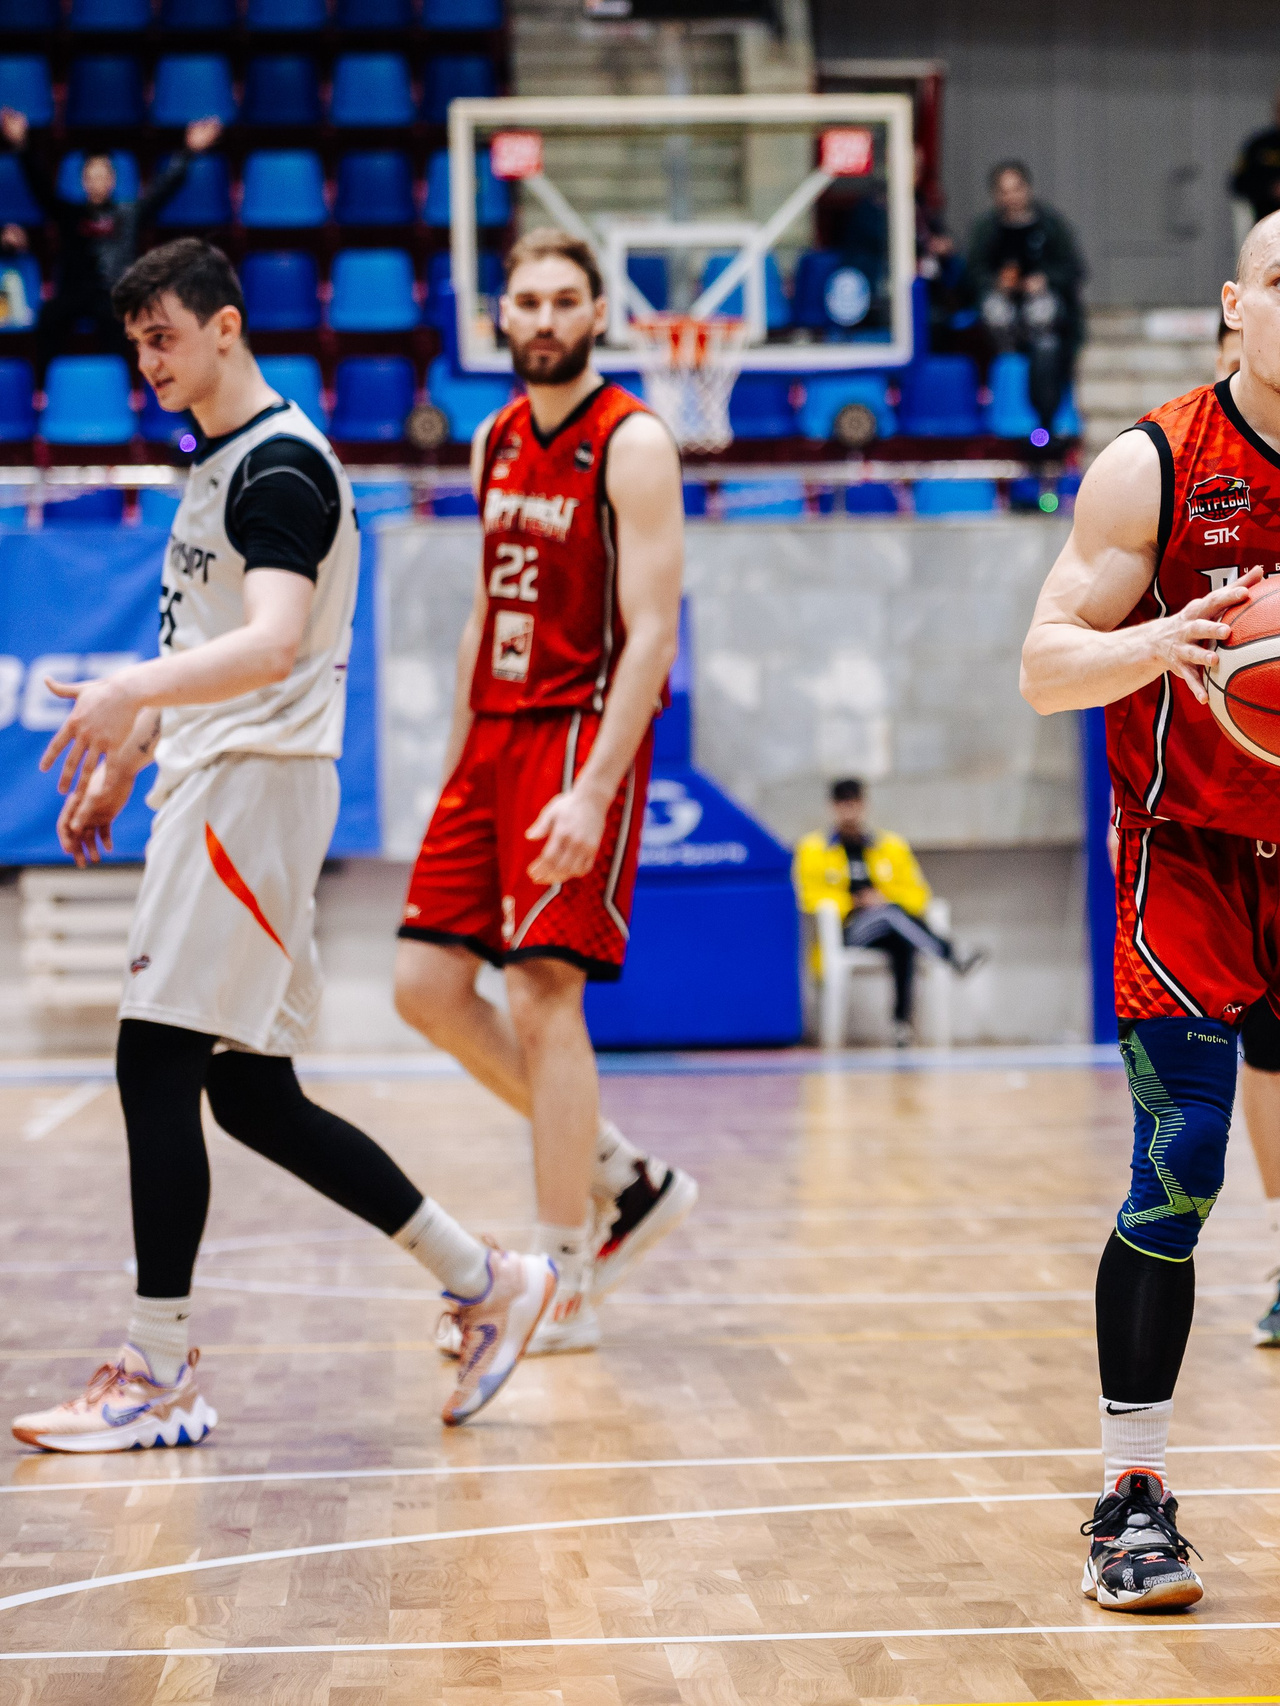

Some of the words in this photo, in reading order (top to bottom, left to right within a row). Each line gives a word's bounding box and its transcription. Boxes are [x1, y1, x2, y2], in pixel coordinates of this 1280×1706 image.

[1191, 488, 1248, 515] ЯСТРЕБЫ
[1204, 525, 1240, 546] STK
[489, 542, 539, 602] 22
